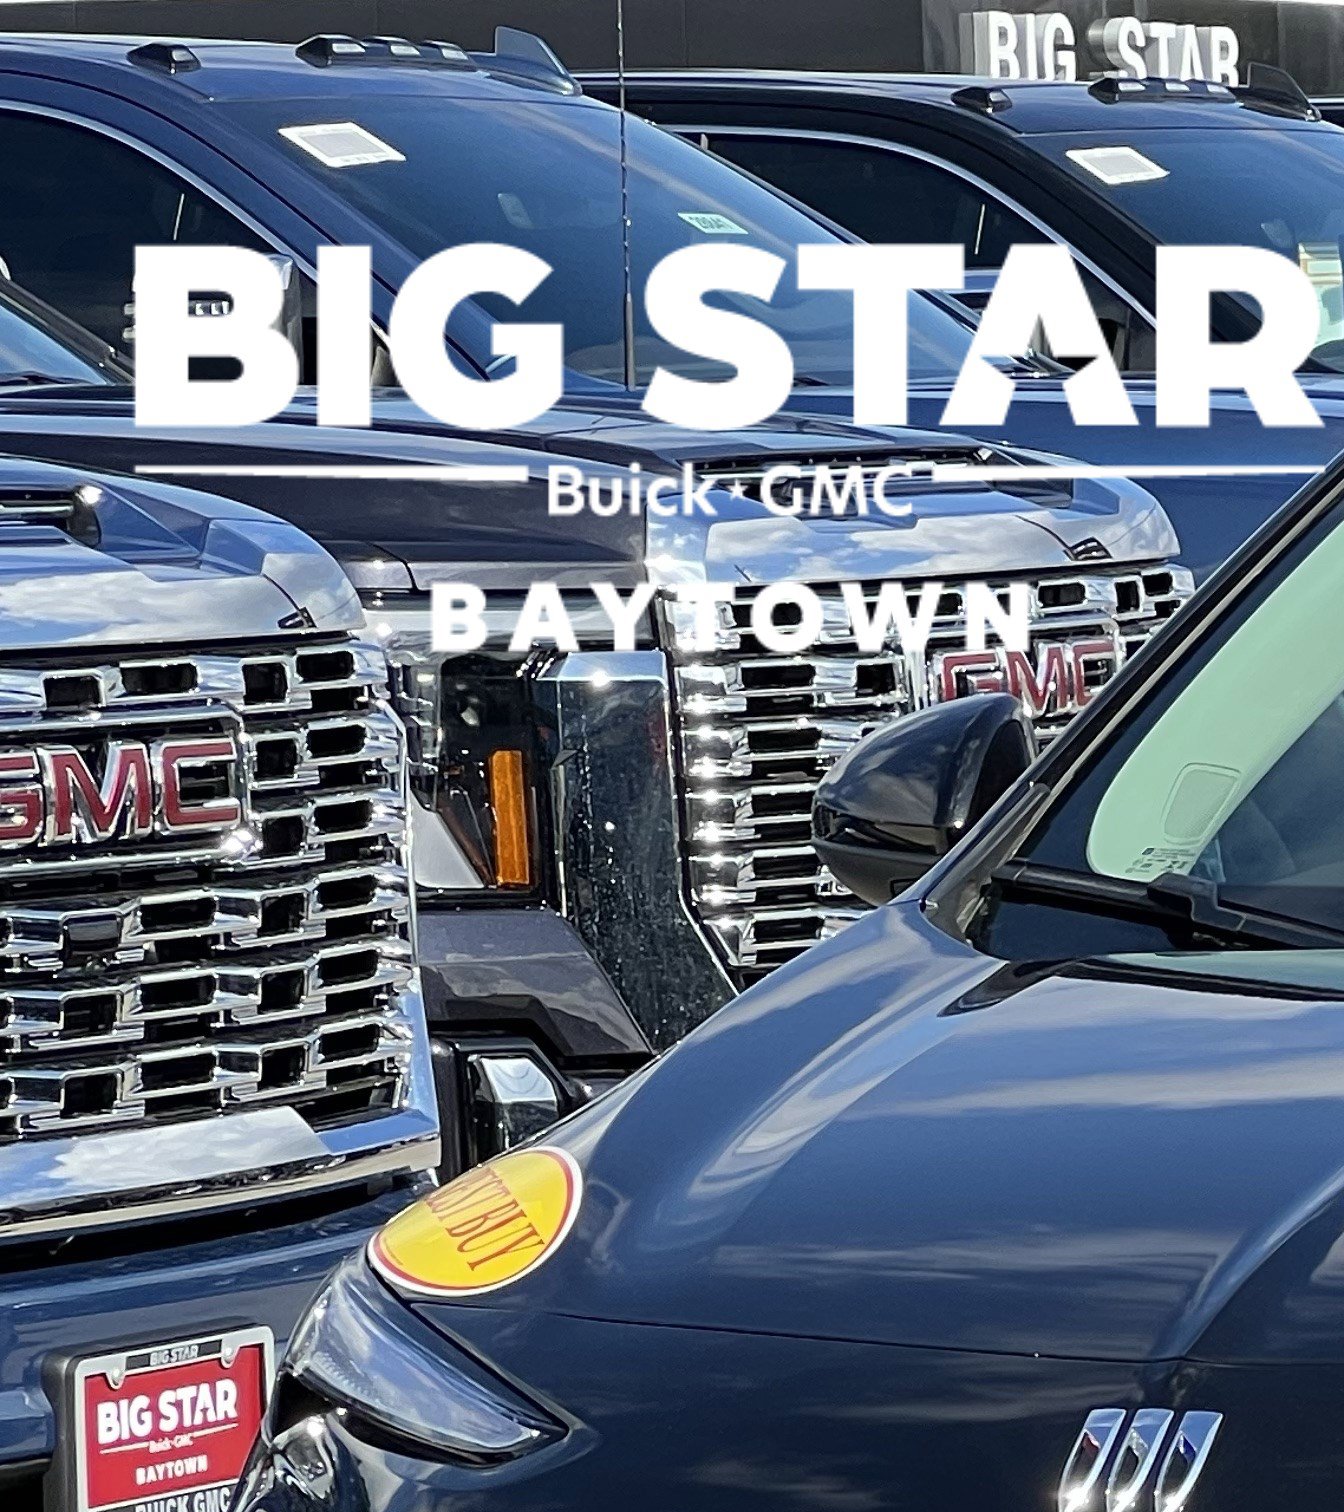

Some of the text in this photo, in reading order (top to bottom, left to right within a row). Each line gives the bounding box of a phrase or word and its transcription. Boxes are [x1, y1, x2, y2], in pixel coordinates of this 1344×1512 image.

[986, 11, 1239, 88] BIG STAR
[423, 1166, 546, 1272] EST BUY
[150, 1345, 200, 1366] BIG STAR
[97, 1378, 238, 1444] BIG STAR
[135, 1455, 209, 1486] BAYTOWN
